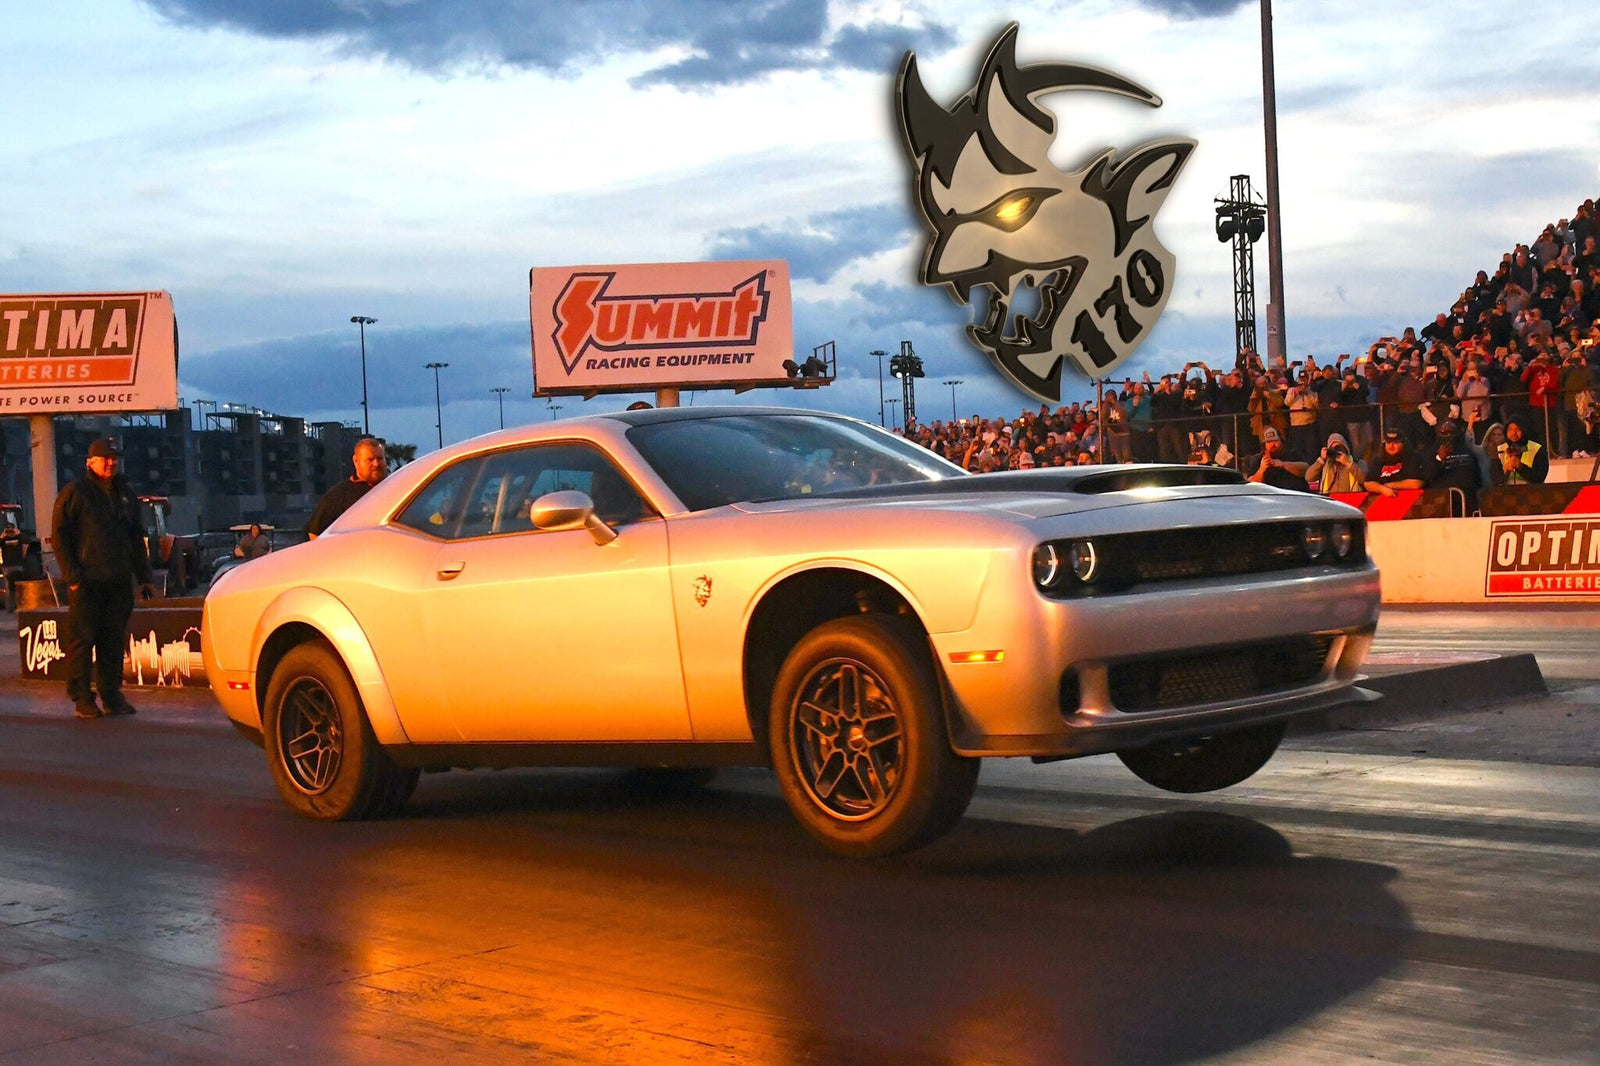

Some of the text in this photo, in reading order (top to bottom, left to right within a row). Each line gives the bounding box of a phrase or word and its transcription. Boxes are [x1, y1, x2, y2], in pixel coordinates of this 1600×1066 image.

[3, 308, 128, 351] TIMA
[586, 352, 755, 370] RACING EQUIPMENT
[1, 363, 91, 380] TTERIES
[20, 394, 70, 406] POWER
[78, 393, 133, 404] SOURCE
[19, 623, 66, 675] Vegas
